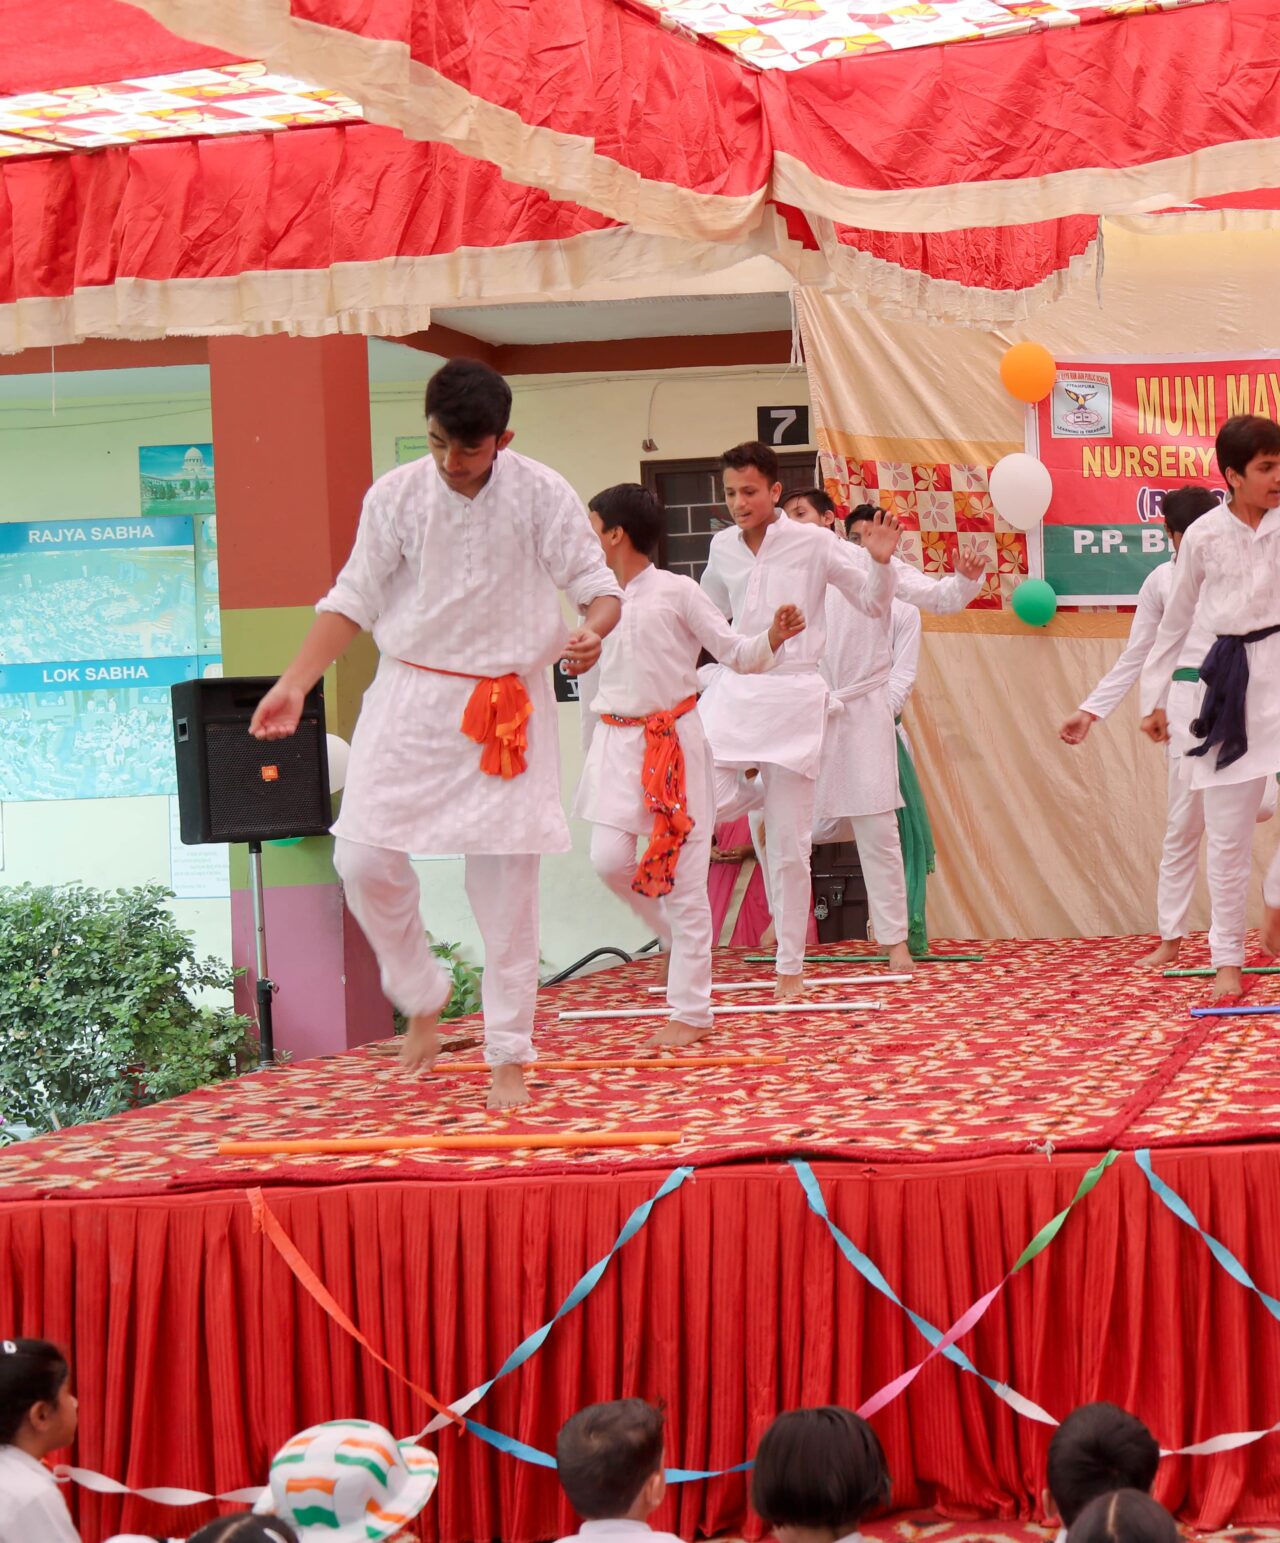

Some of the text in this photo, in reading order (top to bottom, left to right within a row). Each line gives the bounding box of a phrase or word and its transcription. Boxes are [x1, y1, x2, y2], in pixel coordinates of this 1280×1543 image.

[1135, 375, 1217, 437] MUNI
[770, 408, 797, 444] 7
[1082, 445, 1217, 478] NURSERY
[28, 525, 155, 544] RAJYA SABHA
[1073, 529, 1128, 553] P.P.
[42, 665, 149, 683] LOK SABHA
